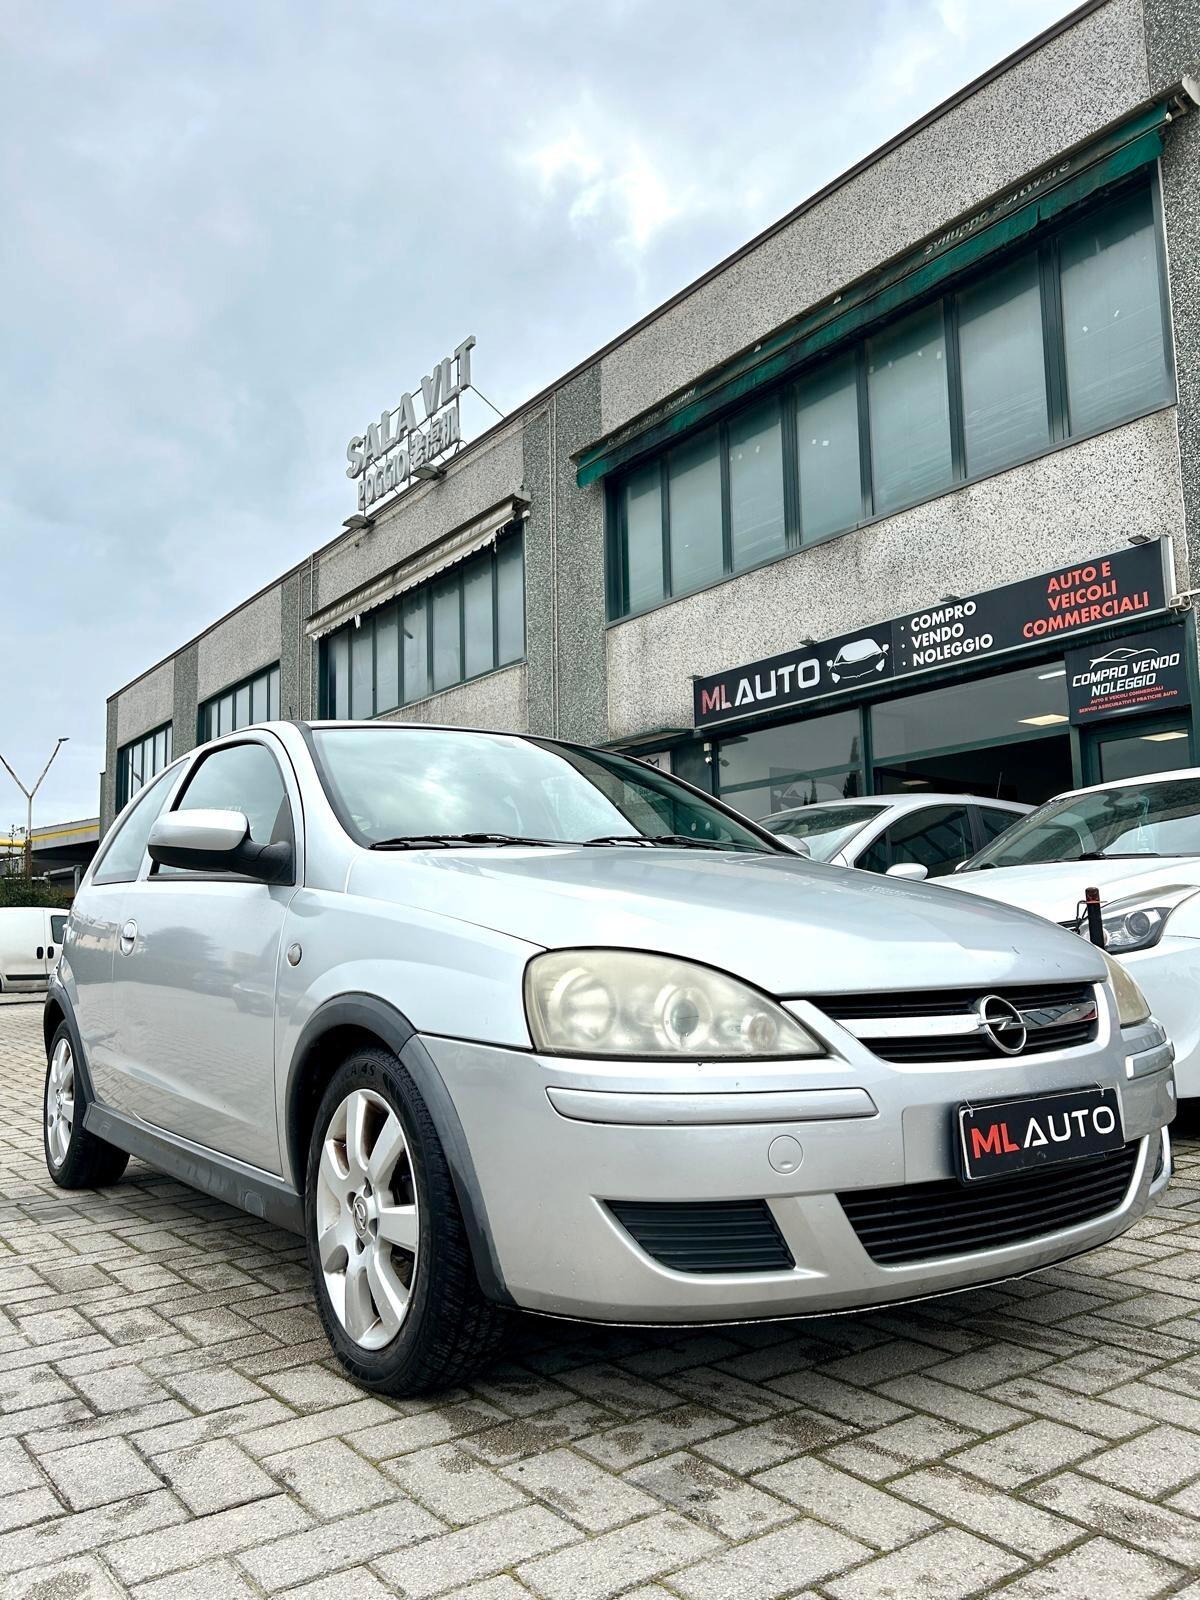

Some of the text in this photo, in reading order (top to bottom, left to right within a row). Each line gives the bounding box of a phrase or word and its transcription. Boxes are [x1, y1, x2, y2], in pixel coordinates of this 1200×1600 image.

[346, 335, 476, 479] SALA VLT
[358, 449, 410, 511] POGGIO
[1047, 561, 1112, 594] AUTO E
[1048, 580, 1117, 612] VEICOLI
[911, 601, 977, 632] COMPRO
[1023, 591, 1149, 639] COMMERCIALI
[911, 623, 965, 650] VENDO
[913, 634, 993, 667] NOLEGGIO
[1072, 653, 1180, 687] COMPRO VENDO
[1091, 673, 1156, 697] NOLEGGIO
[1163, 689, 1178, 697] AUTO
